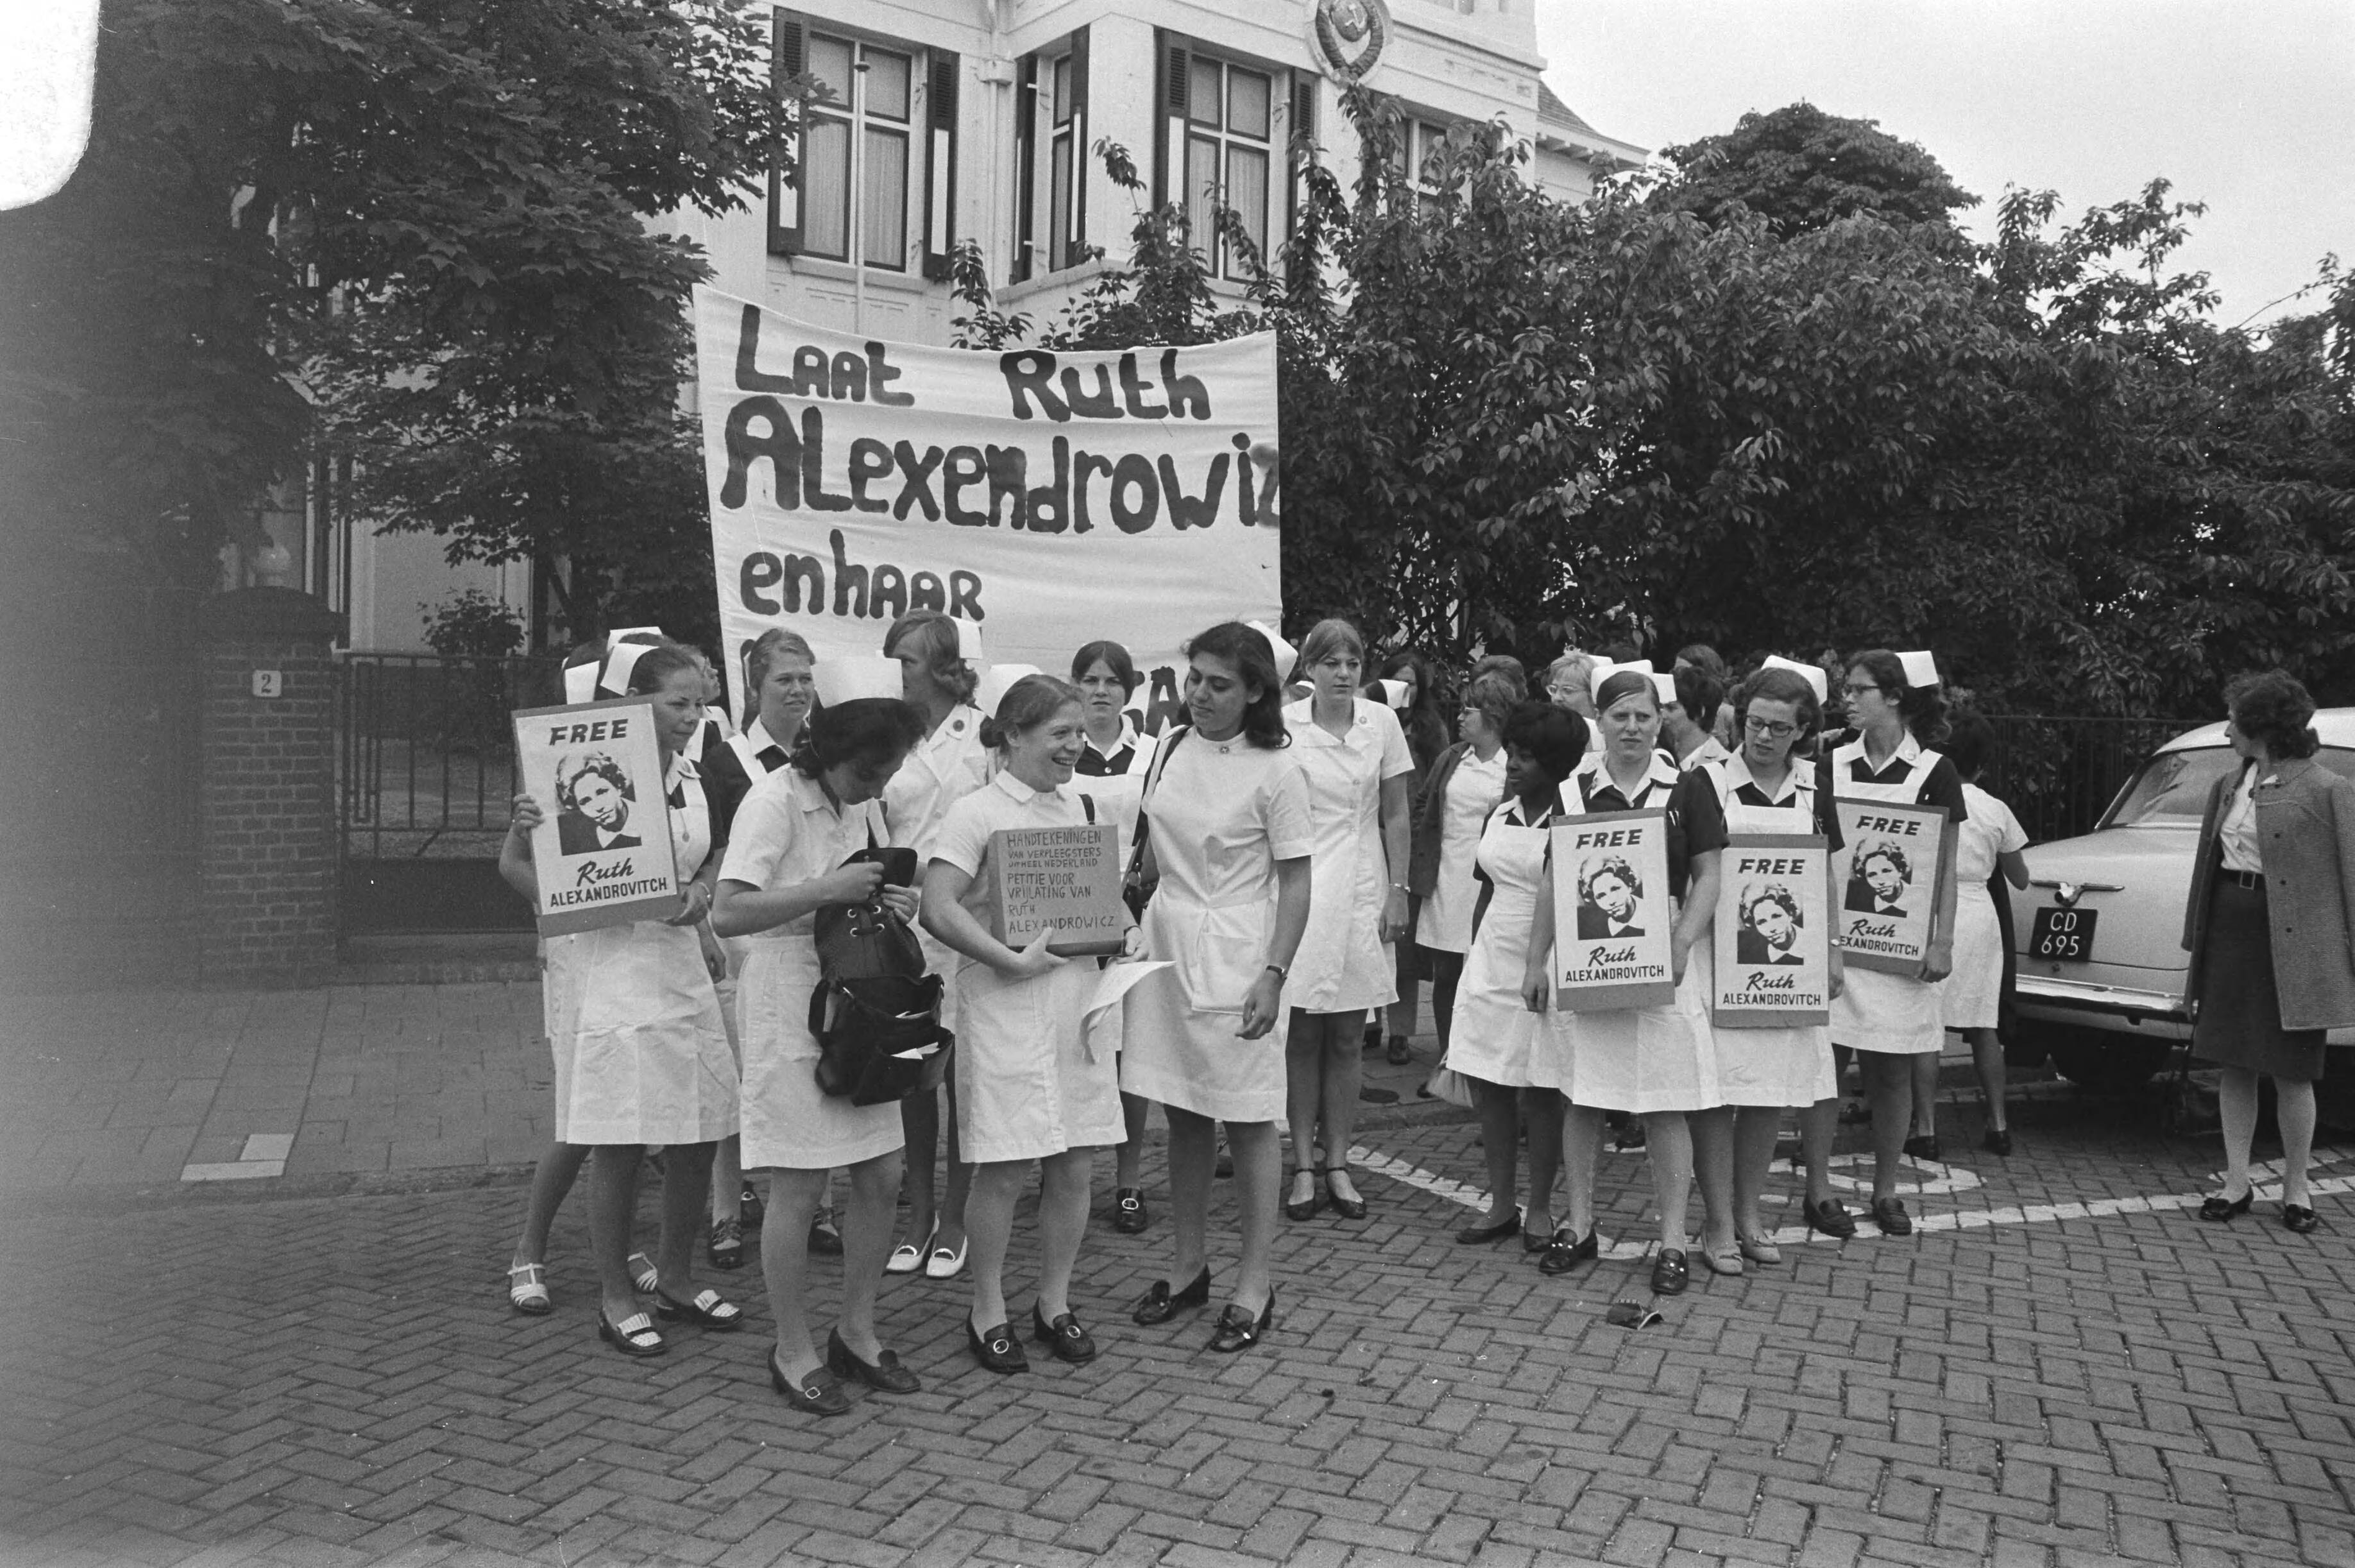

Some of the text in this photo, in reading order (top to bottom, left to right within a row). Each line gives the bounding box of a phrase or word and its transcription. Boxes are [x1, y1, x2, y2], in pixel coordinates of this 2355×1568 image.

[261, 674, 271, 693] 2
[549, 719, 629, 746] FREE
[1856, 815, 1921, 836] FREE
[1007, 830, 1101, 848] HANDTEKENINGEN
[1576, 829, 1642, 849] FREE
[1008, 847, 1101, 859] VAN VERPLEEGSTERS
[576, 857, 634, 887] Ruth
[1738, 859, 1805, 874] FREE
[1007, 871, 1075, 885] PETITIE VOOR
[550, 877, 667, 908] ALEXANDROVITCH
[1070, 885, 1091, 898] VAN
[1008, 903, 1035, 916] RUTH
[1009, 914, 1114, 934] ALEXANDROWICZ
[1849, 919, 1896, 937] Ruth
[2050, 912, 2077, 932] CD
[1840, 935, 1919, 956] EXANDROVITCH
[2041, 935, 2080, 956] 695
[1588, 946, 1637, 967] Ruth
[1565, 965, 1664, 982] ALEXANDROVITCH
[1746, 971, 1795, 991] Ruth
[1722, 993, 1821, 1005] ALEXANDROVITCH
